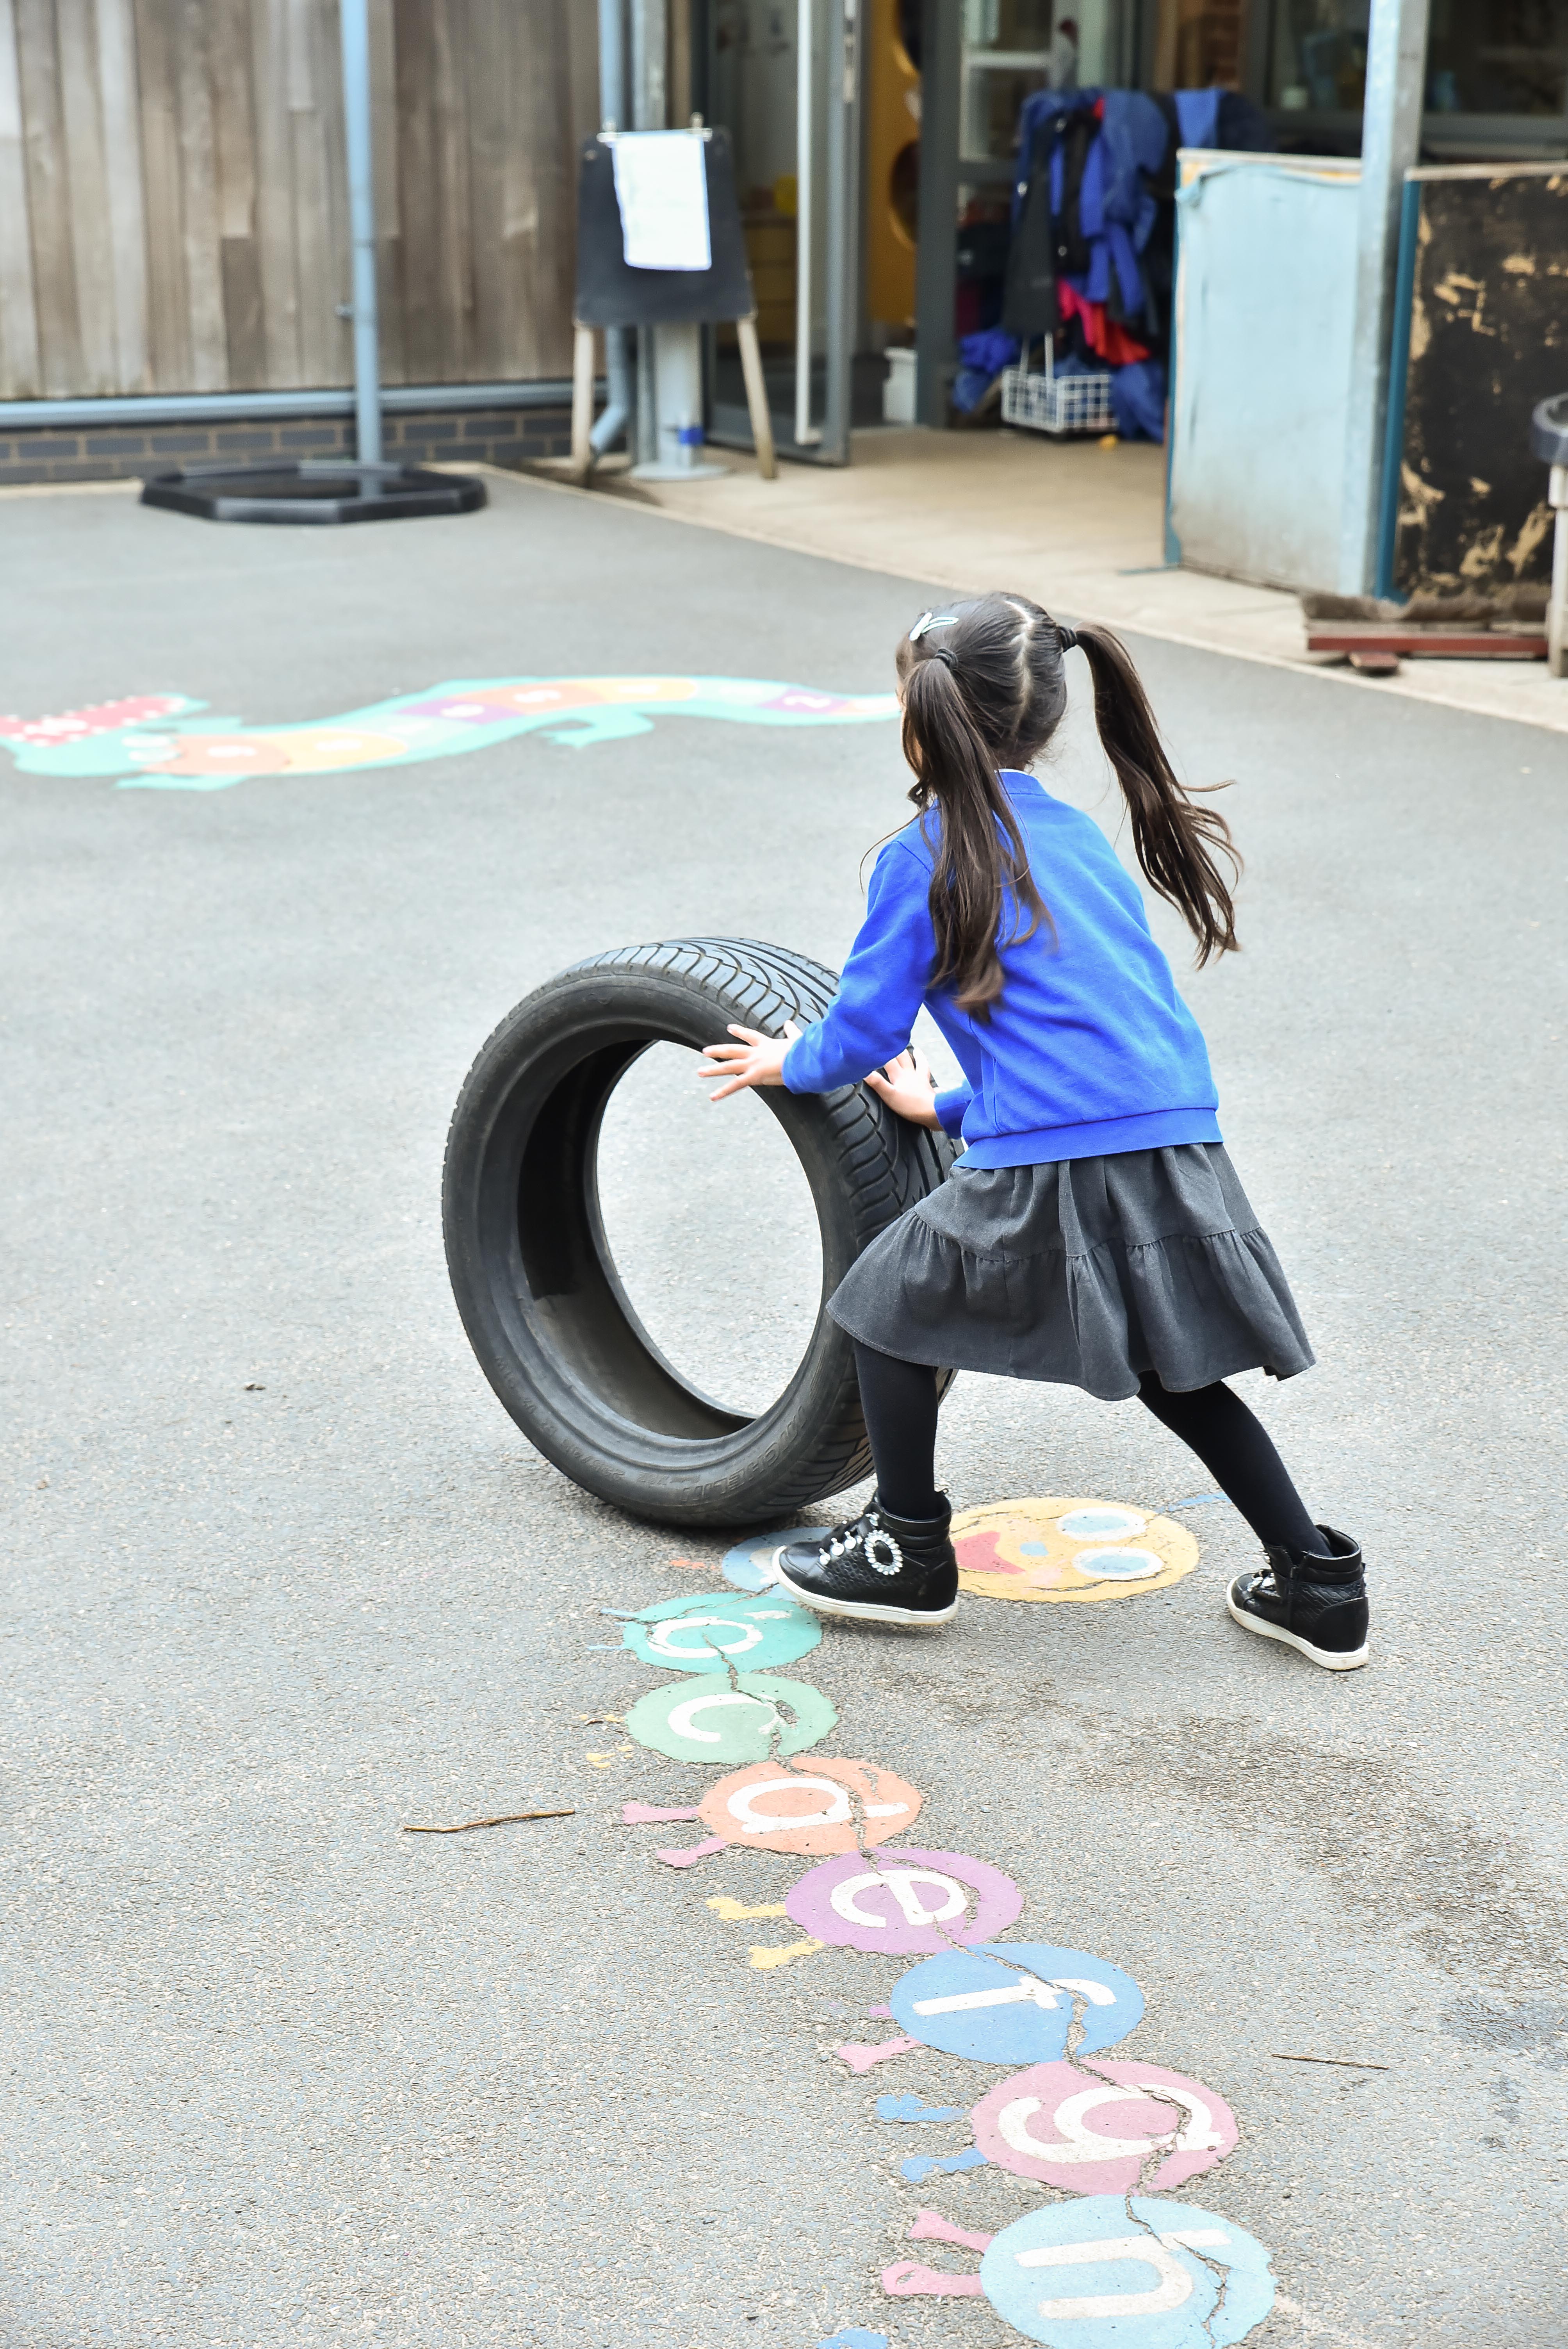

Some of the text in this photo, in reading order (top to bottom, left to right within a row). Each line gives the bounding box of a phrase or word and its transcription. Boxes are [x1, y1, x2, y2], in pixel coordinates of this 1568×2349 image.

[667, 1693, 782, 1743] c
[727, 1777, 911, 1834] d
[829, 1869, 969, 1928] e
[912, 1975, 1117, 2016] f
[998, 2083, 1225, 2164] g
[1014, 2228, 1232, 2320] h
